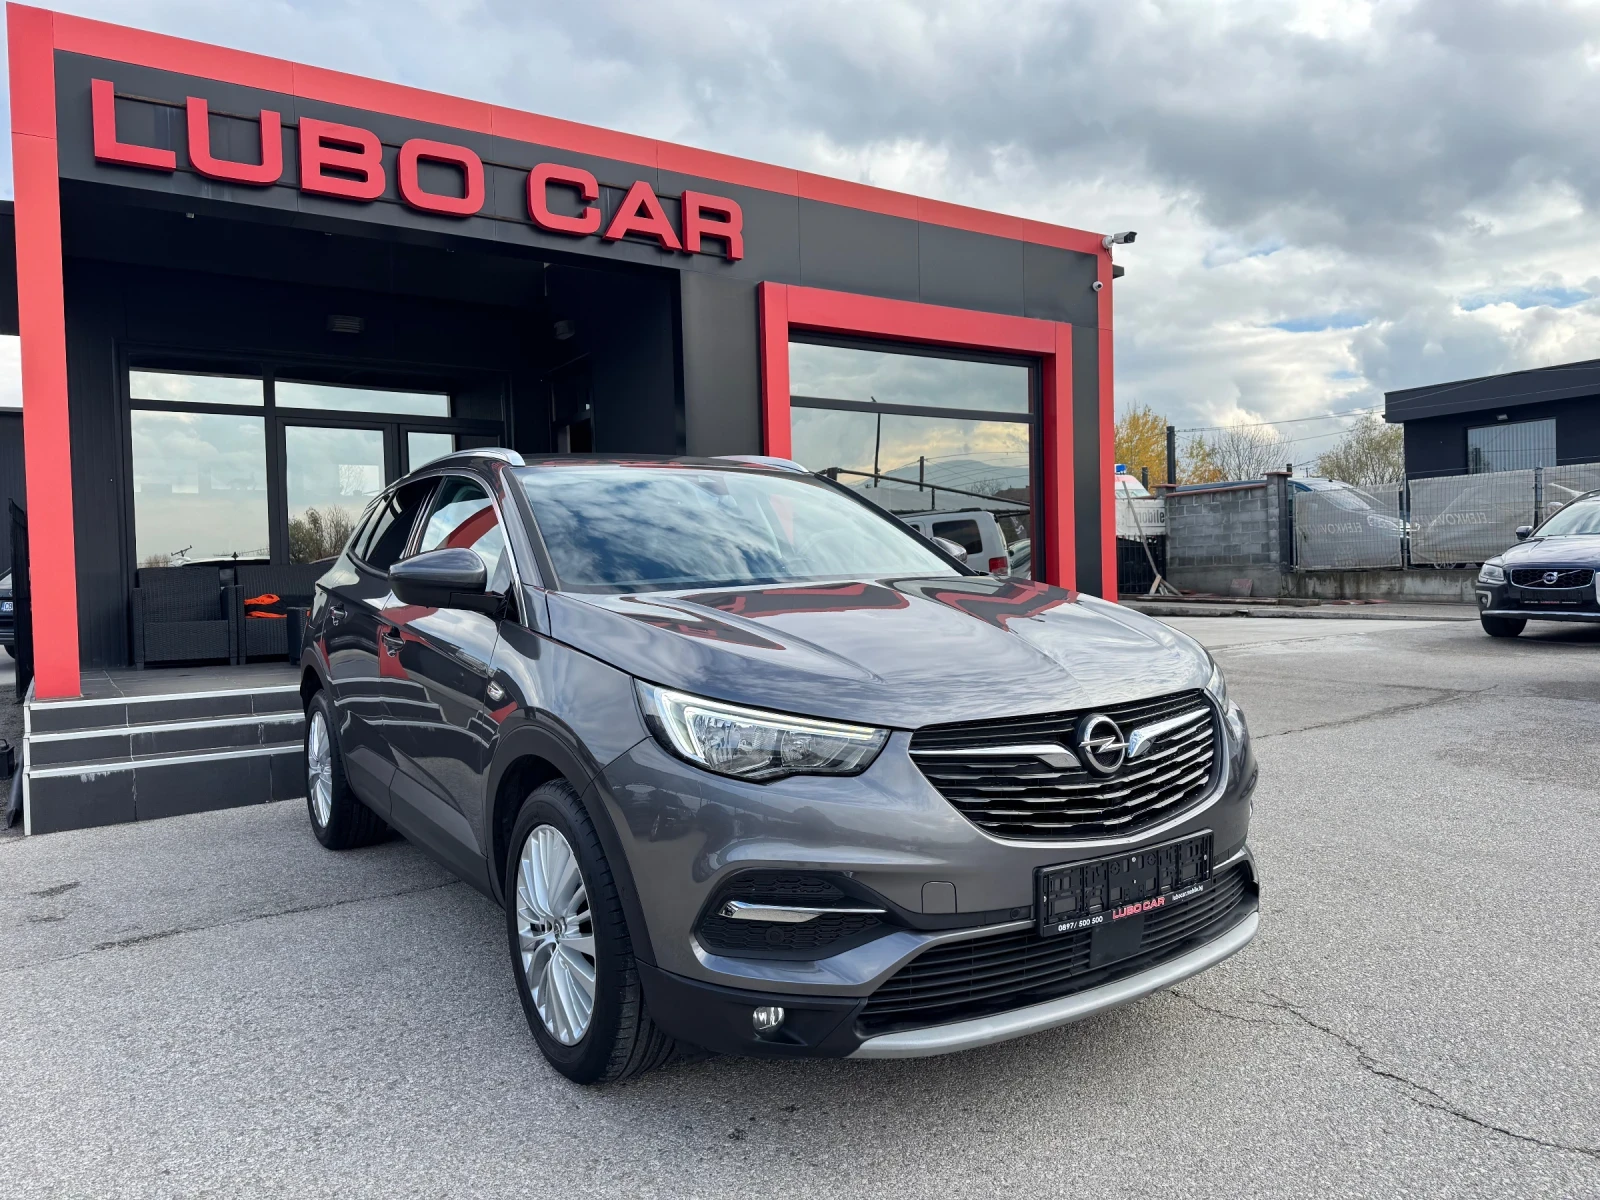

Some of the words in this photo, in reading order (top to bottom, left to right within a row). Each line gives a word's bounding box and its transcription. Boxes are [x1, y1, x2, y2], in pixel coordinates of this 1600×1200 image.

[91, 78, 485, 218] LUBO
[526, 162, 744, 261] CAR
[1112, 904, 1142, 919] LUBO
[1143, 896, 1166, 911] CAR
[1078, 918, 1091, 928] 500
[1091, 915, 1104, 925] 500
